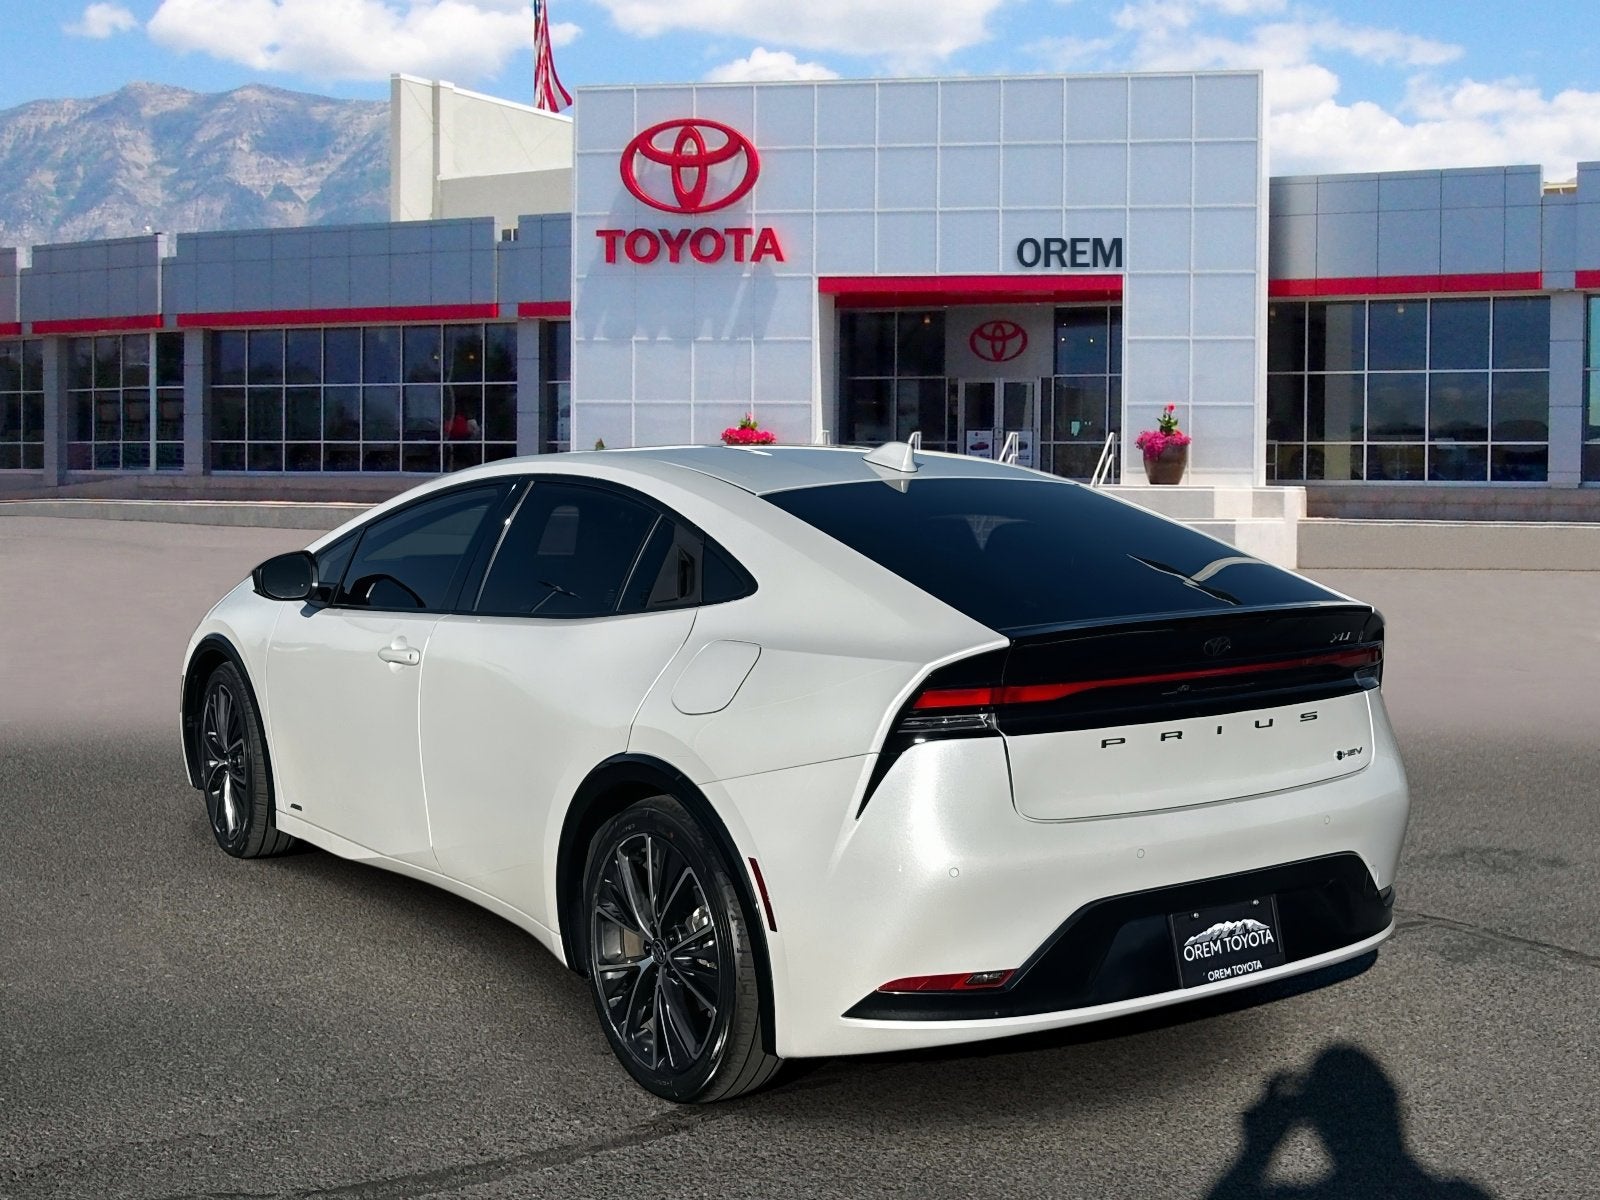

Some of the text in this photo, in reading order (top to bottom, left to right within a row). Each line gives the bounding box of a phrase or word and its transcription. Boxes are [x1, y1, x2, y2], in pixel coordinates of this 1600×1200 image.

[596, 227, 785, 265] TOYOTA
[1017, 237, 1123, 268] OREM
[1101, 711, 1318, 749] PRIUS
[1183, 929, 1275, 962] OREM TOYOTA
[1207, 960, 1263, 981] OREM TOYOTA
